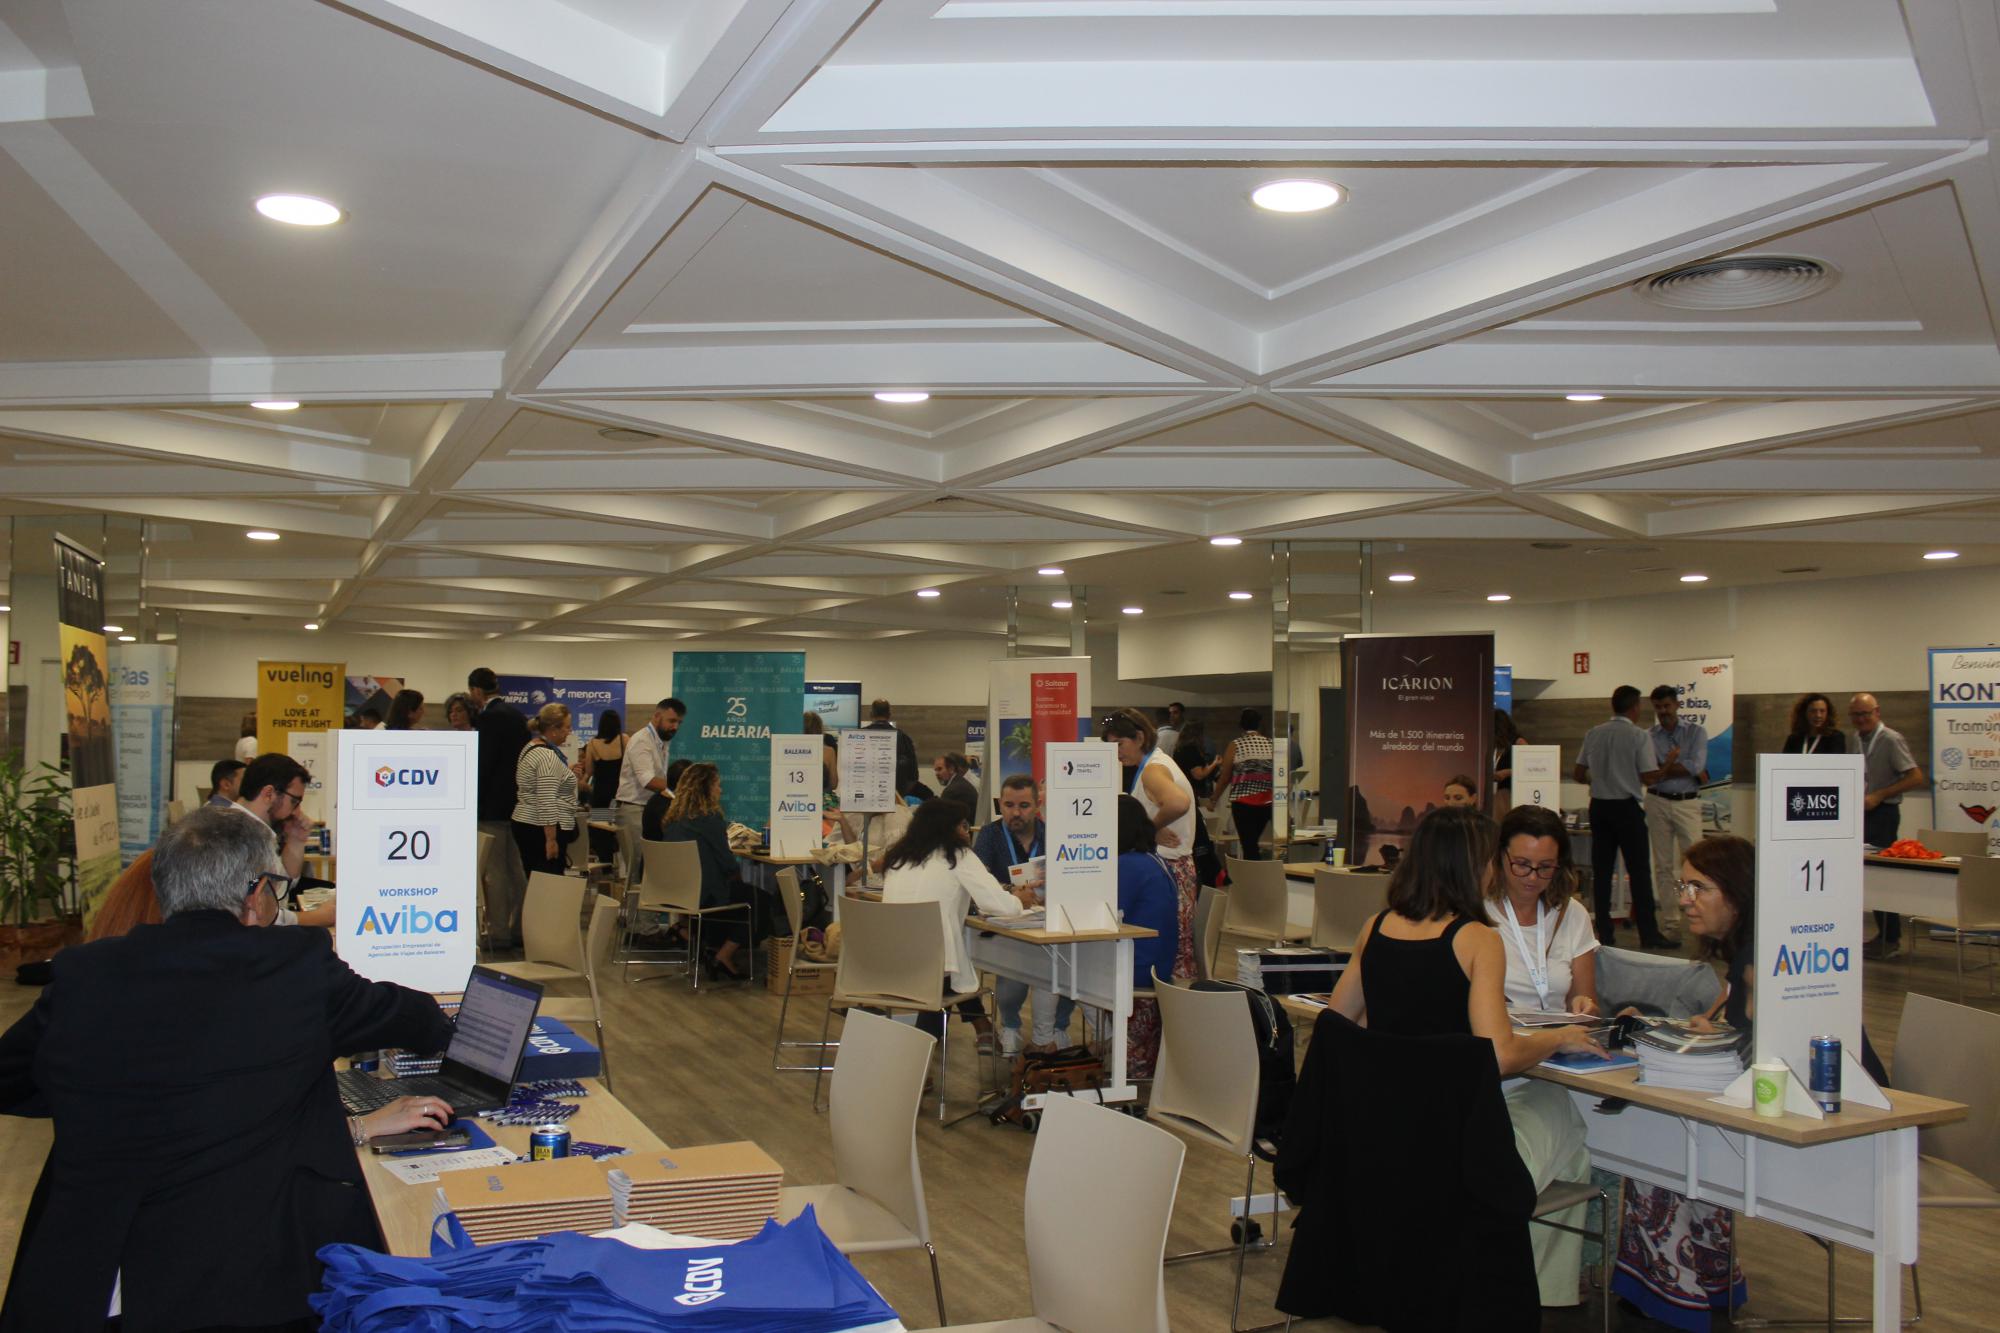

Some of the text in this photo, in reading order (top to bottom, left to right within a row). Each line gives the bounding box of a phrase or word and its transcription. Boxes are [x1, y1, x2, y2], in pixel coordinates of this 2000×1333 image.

[267, 664, 333, 689] vueling
[1382, 675, 1453, 690] ICÁRION
[567, 690, 611, 699] menorca
[284, 708, 320, 717] LOVE AT
[726, 696, 747, 717] 25
[272, 719, 332, 729] FIRST FLIGHT
[1369, 729, 1465, 740] Más de 1.500 itinerarios
[1382, 741, 1465, 752] alrededor del mundo
[398, 769, 439, 786] CDV
[788, 770, 804, 784] 13
[1533, 789, 1541, 804] 9
[1806, 794, 1837, 809] MSC
[778, 800, 816, 812] Aviba
[1072, 798, 1093, 816] 12
[387, 830, 430, 861] 20
[1055, 843, 1109, 862] Aviba
[1801, 859, 1825, 892] 11
[379, 887, 439, 897] WORKSHOP
[356, 904, 458, 936] Aviba
[1790, 923, 1836, 935] WORKSHOP
[1772, 942, 1849, 977] Aviba
[683, 1257, 724, 1292] CDV
